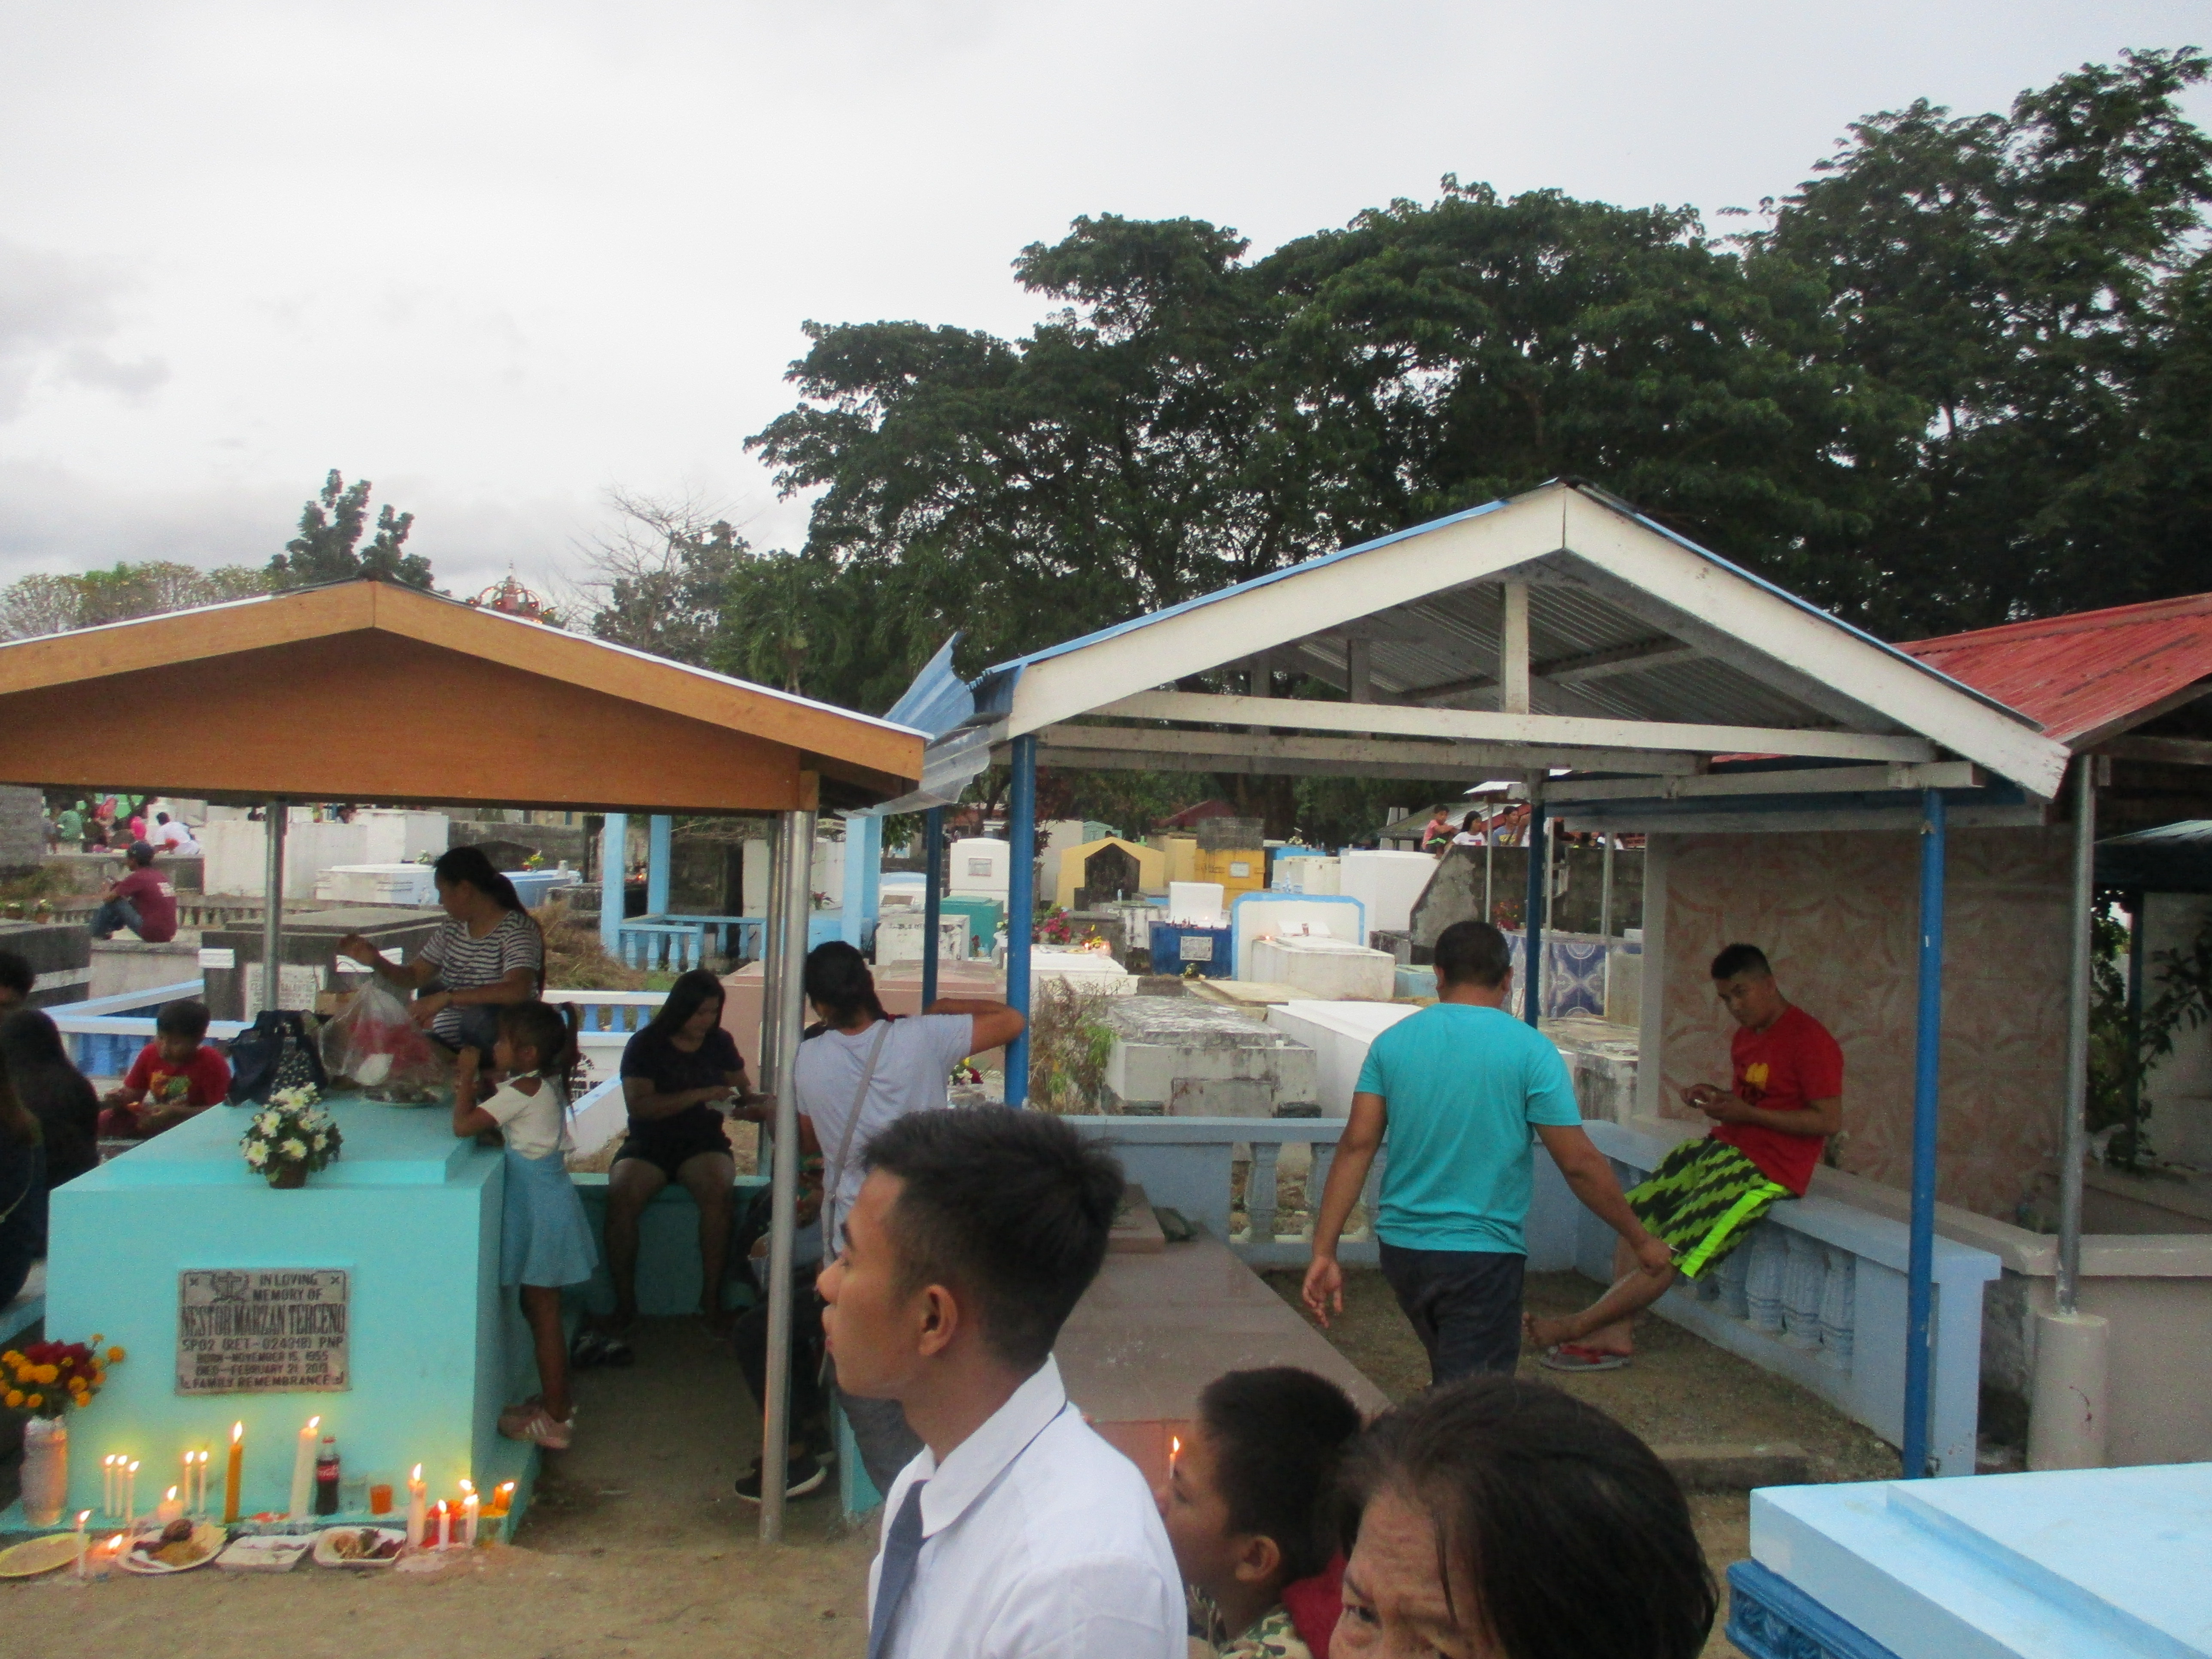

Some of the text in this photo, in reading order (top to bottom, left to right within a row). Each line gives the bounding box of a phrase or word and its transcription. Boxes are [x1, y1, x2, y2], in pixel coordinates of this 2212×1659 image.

[260, 1274, 318, 1286] IN LOVING
[253, 1288, 323, 1301] MEMORY OF
[319, 1336, 344, 1349] PNP
[193, 1375, 331, 1389] FAMILY REMEMBRANCE
